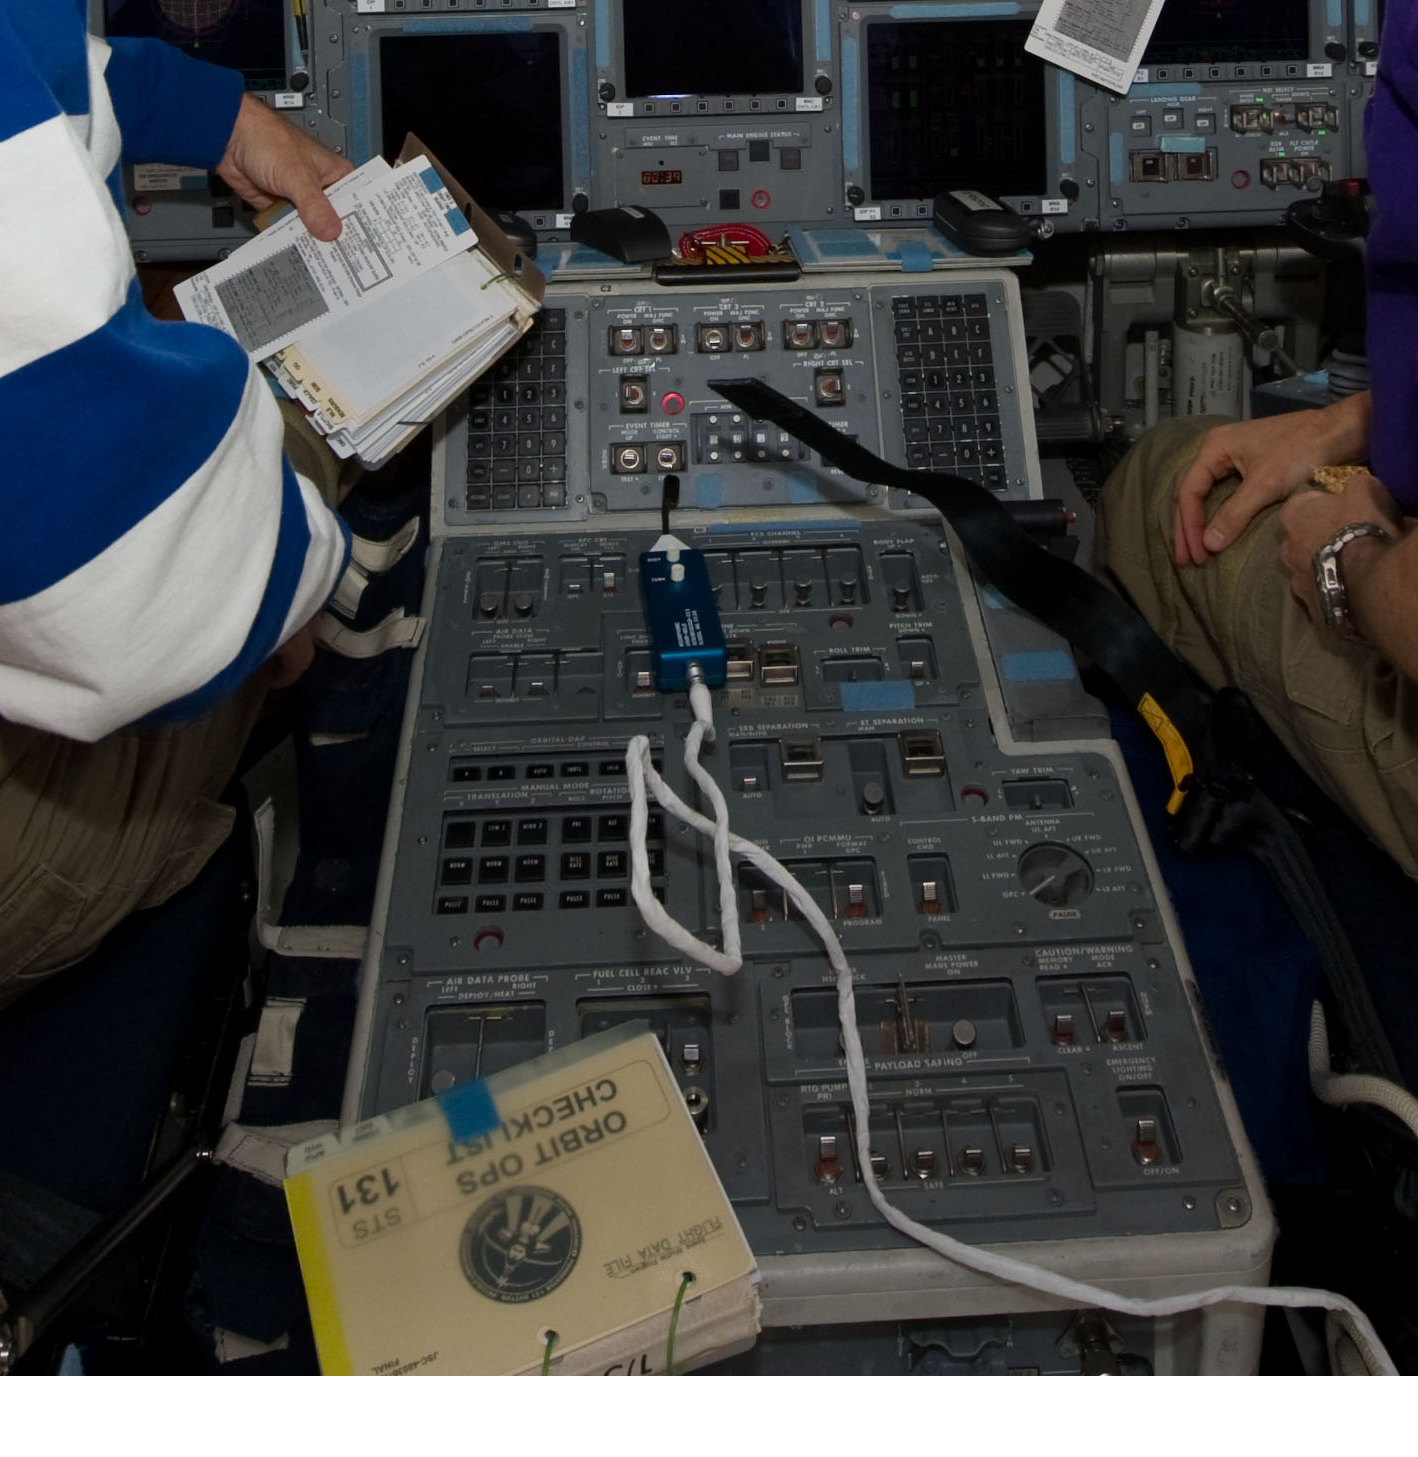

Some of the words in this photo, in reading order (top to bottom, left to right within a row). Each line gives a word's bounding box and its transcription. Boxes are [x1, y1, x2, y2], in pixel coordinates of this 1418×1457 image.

[600, 285, 612, 293] C2
[888, 621, 909, 629] PITCH
[914, 621, 933, 629] TRIM
[521, 783, 560, 792] MANUAL
[563, 782, 590, 790] MODE
[467, 791, 528, 801] TRANSLATION
[971, 814, 1006, 823] S-BAND
[1008, 813, 1023, 822] PM
[1035, 945, 1134, 958] CAUTION/WARNING
[935, 954, 968, 963] MASTER
[593, 970, 615, 979] FUEL
[619, 969, 641, 978] CELL
[644, 967, 670, 976] REAC
[674, 966, 693, 975] VLV
[446, 977, 464, 986] AIR
[467, 976, 494, 985] DATA
[497, 974, 530, 983] PROBE
[1112, 1043, 1144, 1051] ASCENT
[874, 1059, 922, 1071] PAYLOAD
[924, 1057, 963, 1068] SAFING
[1105, 1057, 1157, 1067] EMERGENCY
[1112, 1065, 1154, 1073] LIGHTING
[1118, 1072, 1154, 1081] ON/OFF
[535, 1109, 627, 1166] ORBIT
[456, 1153, 524, 1196] OPS
[1143, 1167, 1180, 1176] OFF/ON
[337, 1167, 400, 1215] 131
[352, 1207, 402, 1241] STS
[679, 1214, 723, 1248] FLIGHT
[636, 1237, 672, 1264] DATA
[603, 1255, 633, 1277] FILE
[371, 1357, 400, 1374] FINAL
